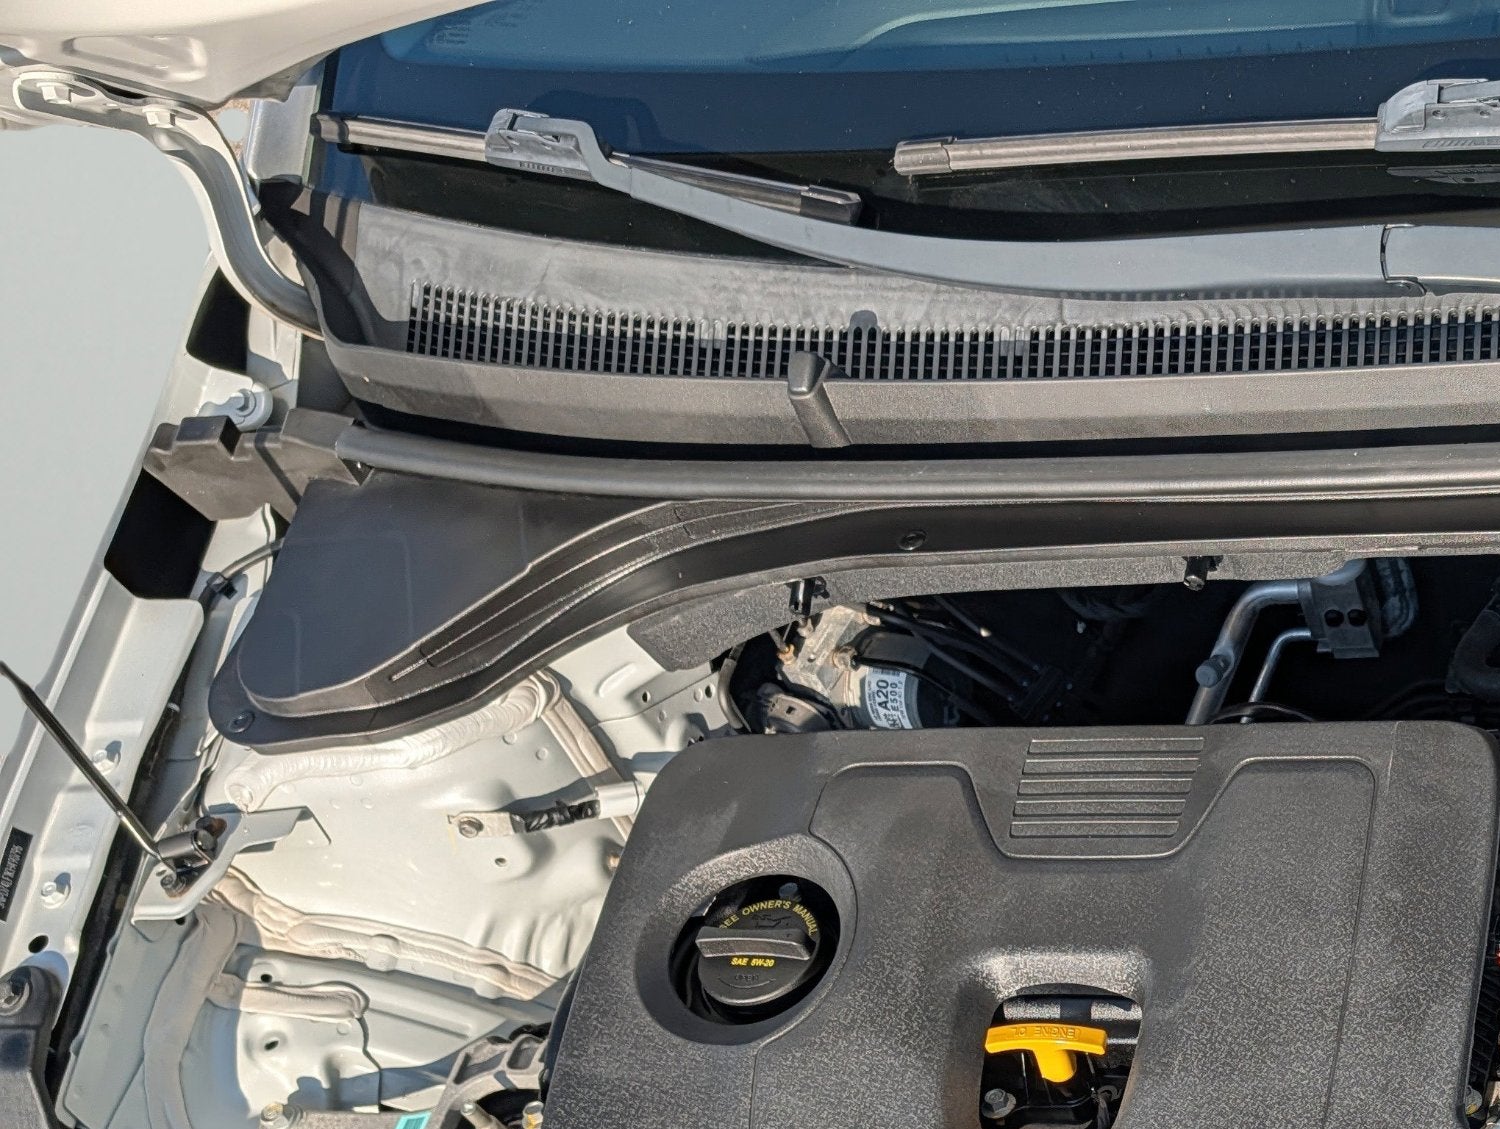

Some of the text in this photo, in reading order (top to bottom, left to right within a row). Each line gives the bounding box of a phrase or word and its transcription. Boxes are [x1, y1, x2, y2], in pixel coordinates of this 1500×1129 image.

[876, 680, 890, 711] A20
[890, 683, 899, 711] E500
[742, 900, 791, 916] OWNER'S
[793, 905, 818, 935] MANUAL
[751, 958, 774, 967] 5W-20
